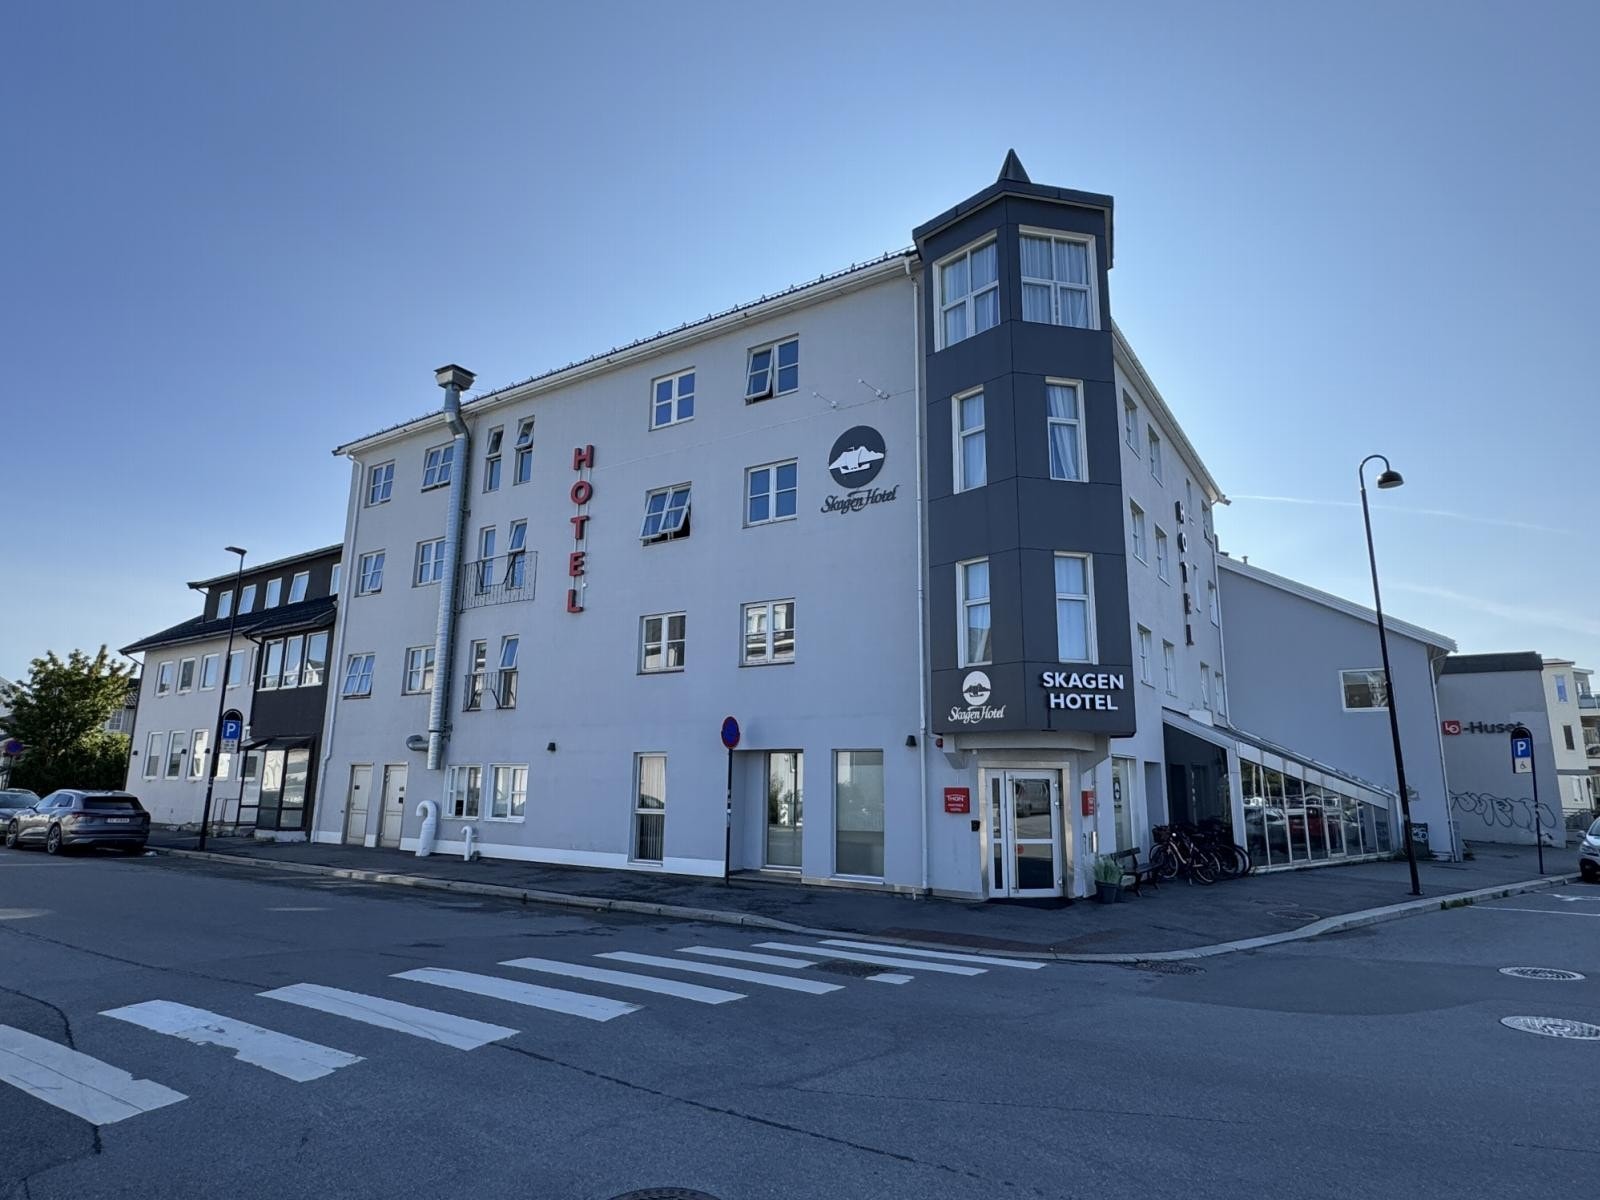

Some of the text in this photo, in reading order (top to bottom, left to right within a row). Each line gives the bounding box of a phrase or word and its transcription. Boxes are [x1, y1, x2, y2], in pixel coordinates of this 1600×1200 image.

[820, 484, 900, 515] Skagen Hotel
[567, 444, 594, 613] HOTEL
[1042, 671, 1124, 690] SKAGEN
[1049, 692, 1119, 711] HOTEL
[948, 704, 1006, 724] Skagen Hotel
[226, 722, 236, 737] P
[1516, 741, 1527, 756] P
